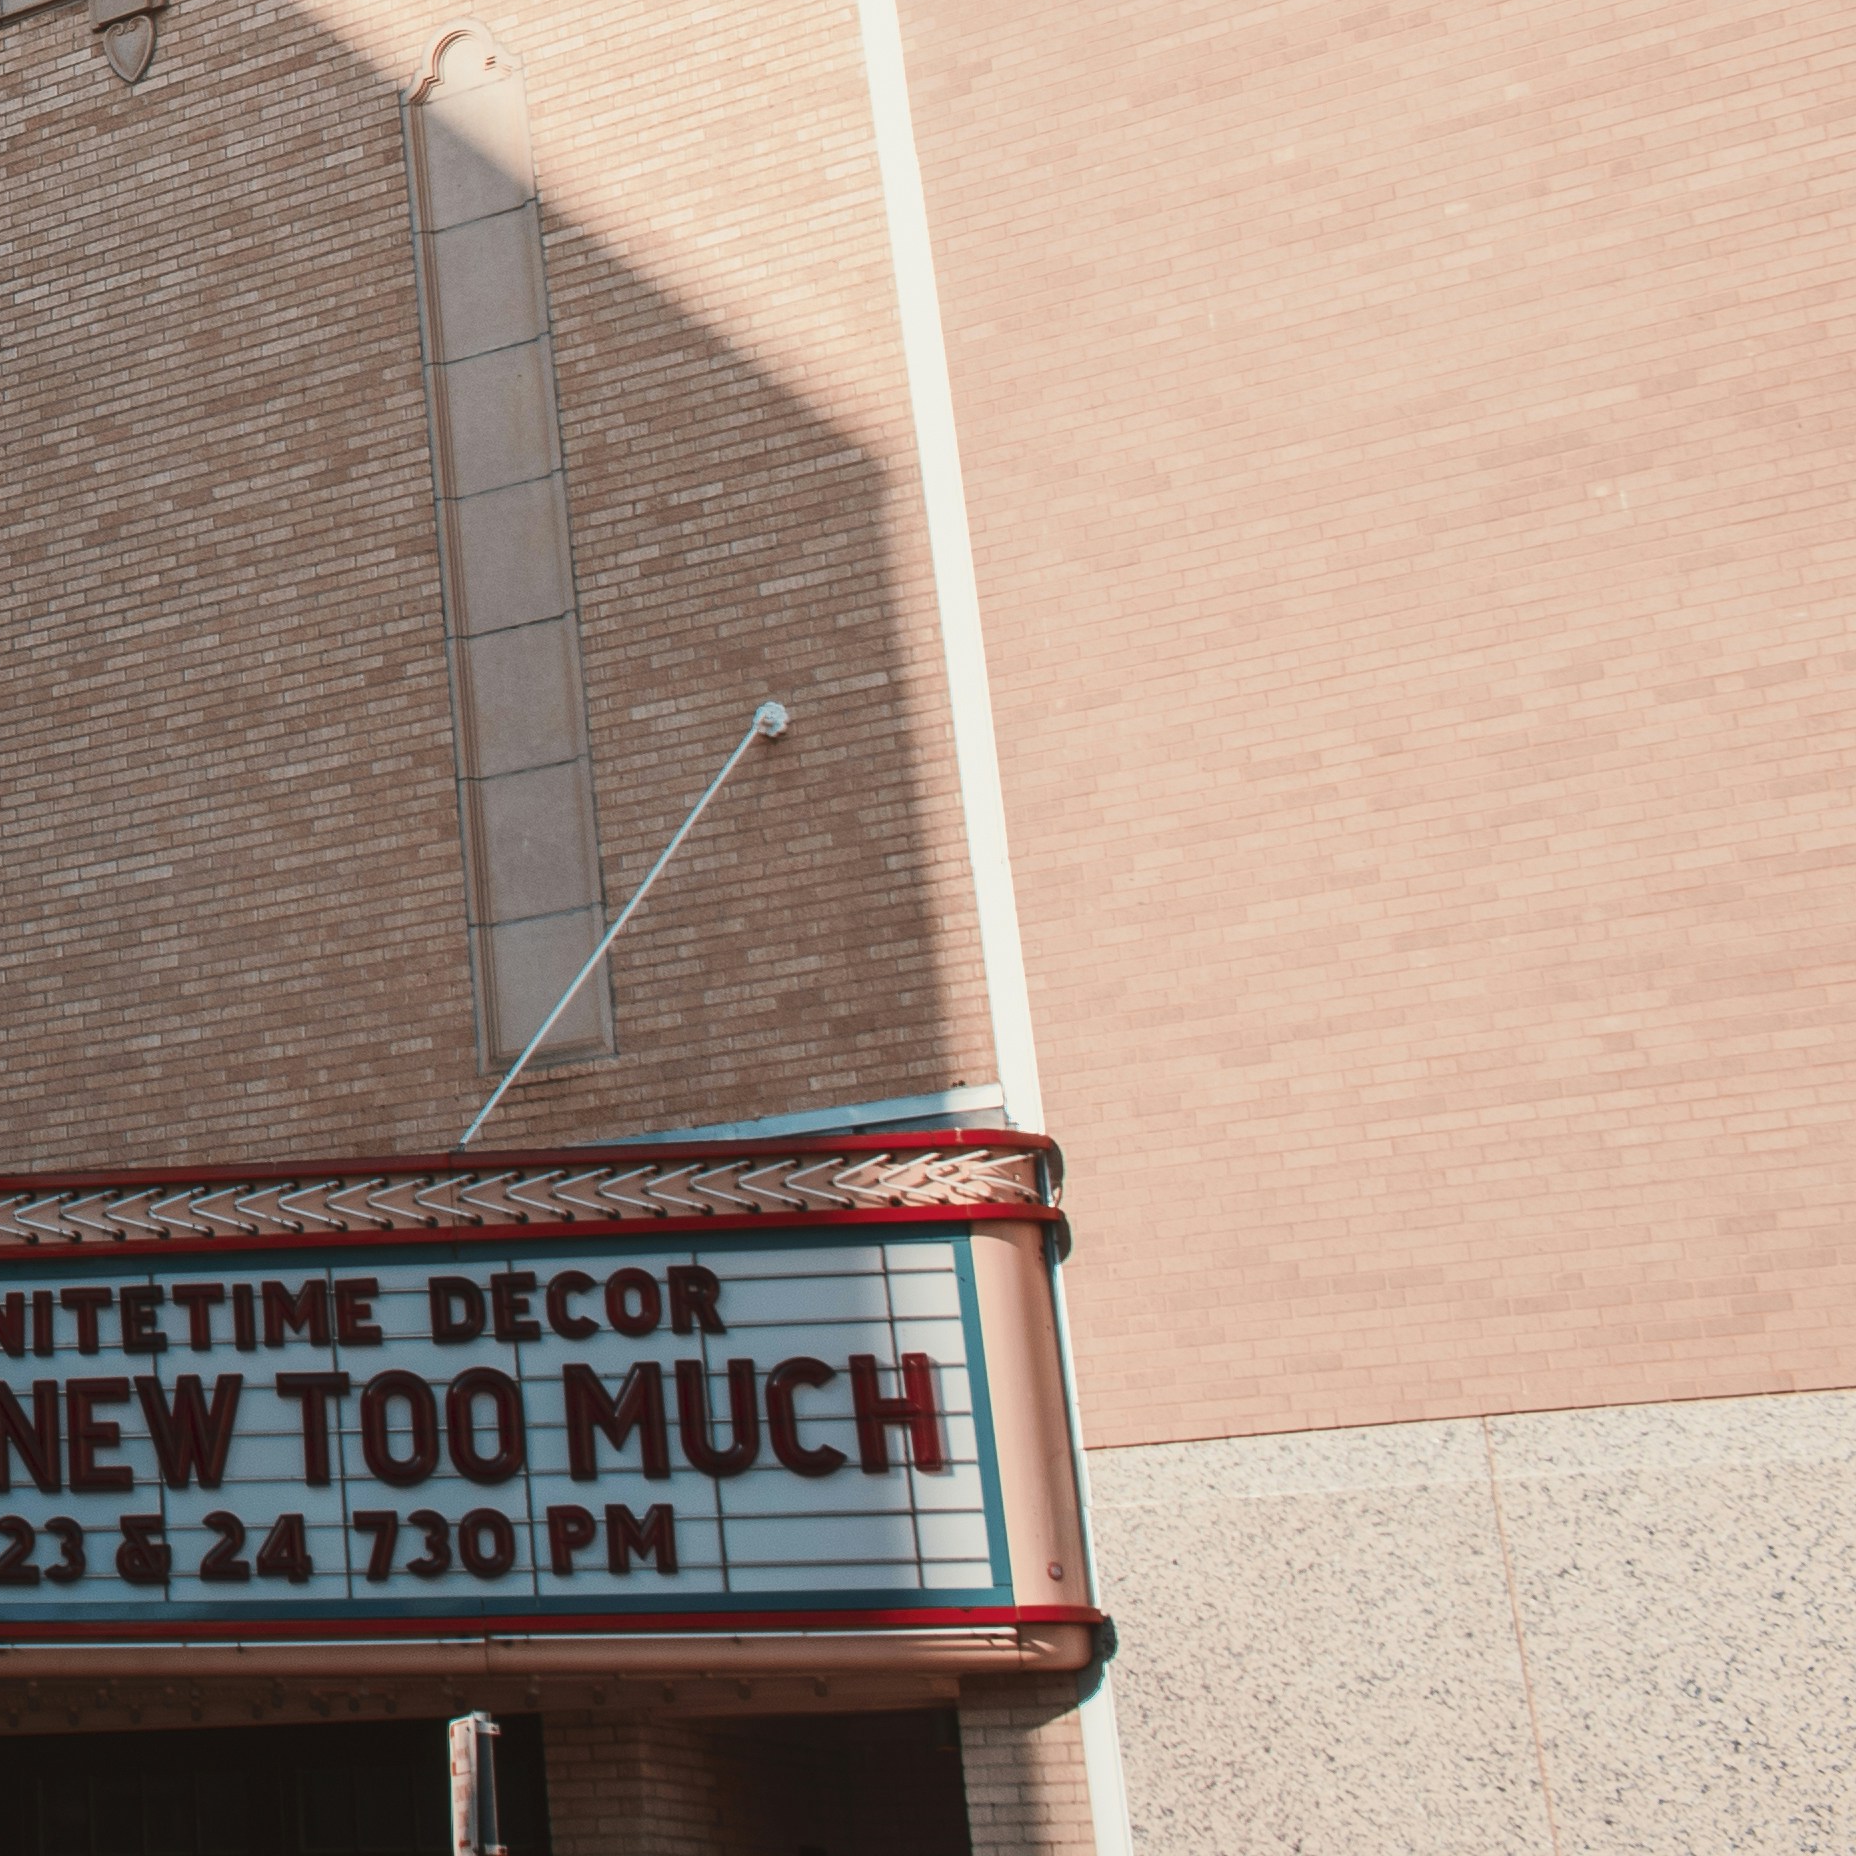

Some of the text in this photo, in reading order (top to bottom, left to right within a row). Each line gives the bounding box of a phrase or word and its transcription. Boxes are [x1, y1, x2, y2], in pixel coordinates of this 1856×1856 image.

[428, 1264, 729, 1346] DECOR
[275, 1365, 528, 1488] TOO
[561, 1352, 944, 1484] MUCH
[115, 1513, 173, 1587] &
[199, 1510, 314, 1584] 24
[352, 1507, 519, 1584] 730
[548, 1503, 680, 1578] PM
